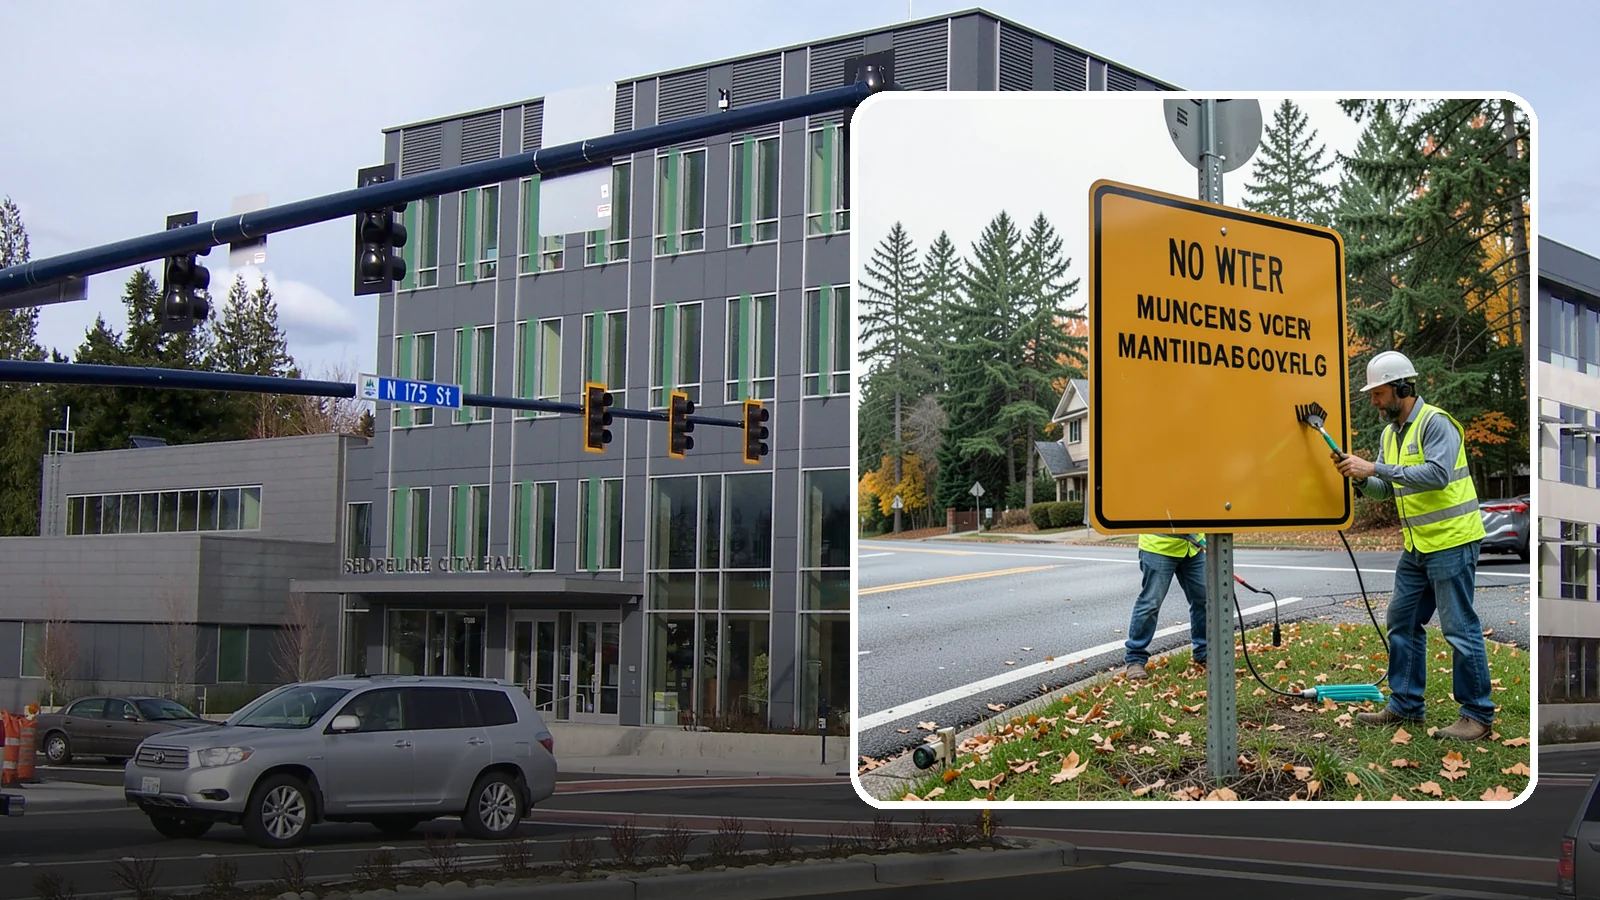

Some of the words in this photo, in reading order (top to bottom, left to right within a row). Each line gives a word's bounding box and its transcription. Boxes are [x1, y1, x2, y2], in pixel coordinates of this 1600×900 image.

[1169, 238, 1204, 281] NO
[1215, 245, 1284, 294] WTER
[1137, 294, 1252, 333] MUNCENS
[387, 380, 396, 400] N
[405, 382, 428, 403] 175
[436, 386, 452, 406] St
[344, 556, 433, 574] SHORELINE
[438, 556, 476, 573] CITY
[483, 555, 526, 572] HALL
